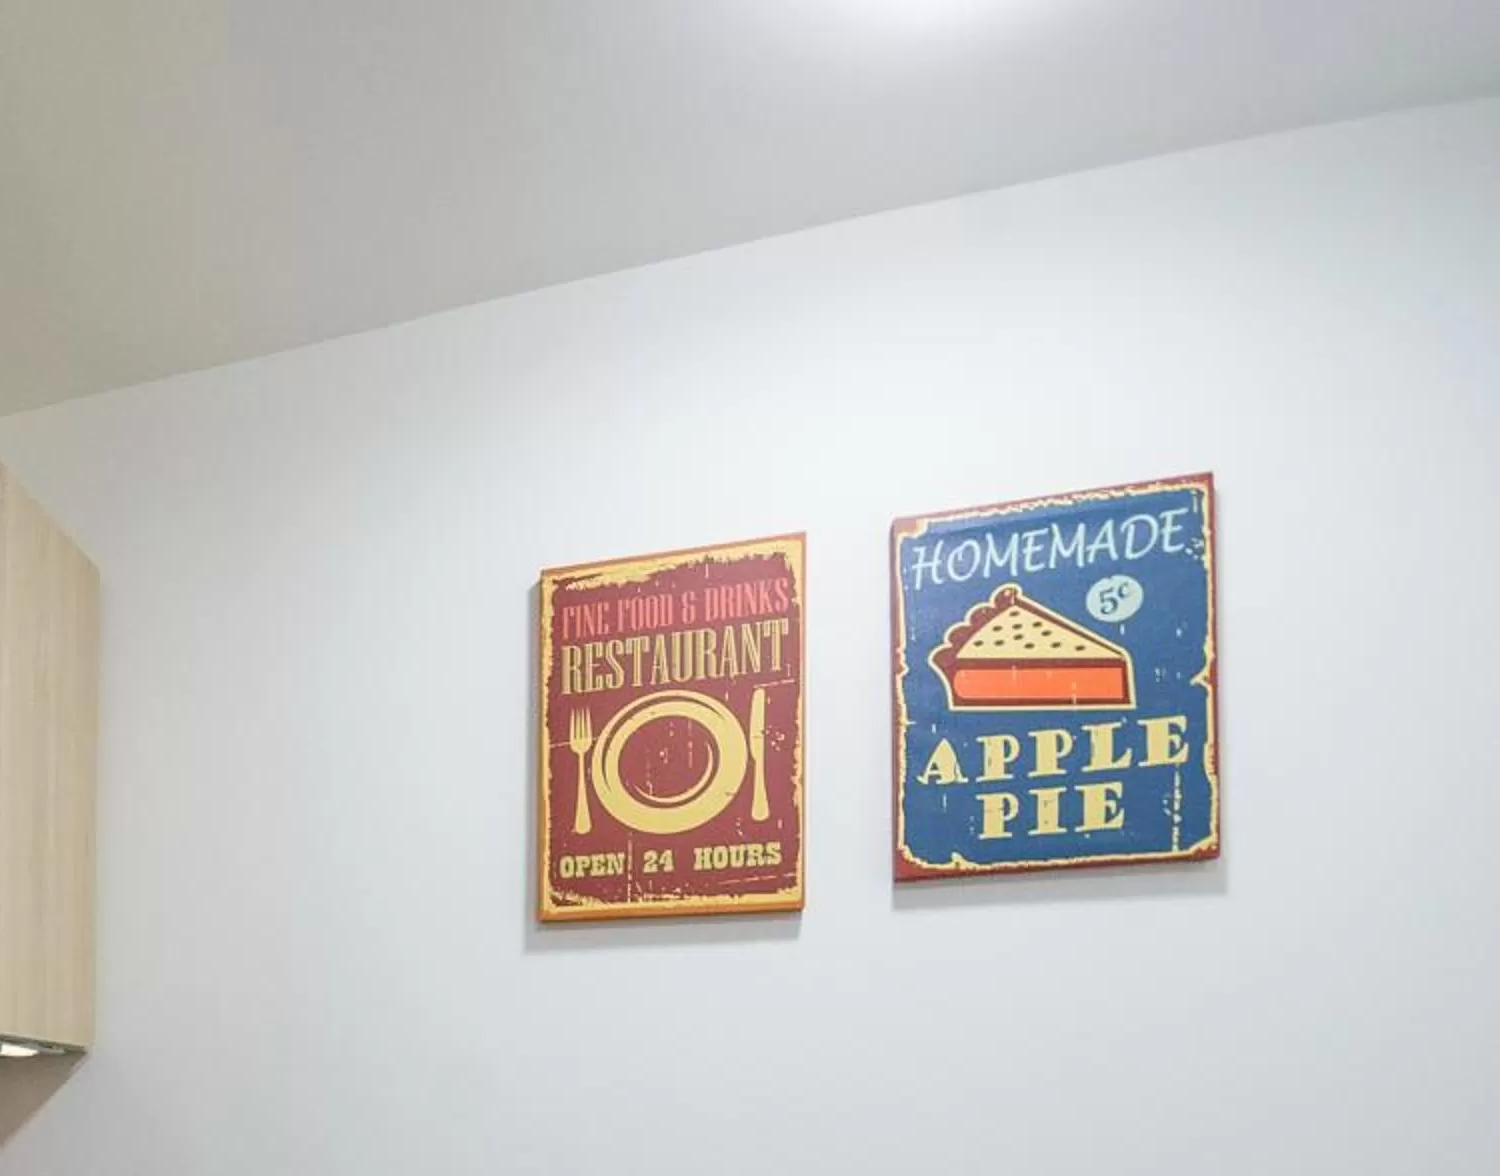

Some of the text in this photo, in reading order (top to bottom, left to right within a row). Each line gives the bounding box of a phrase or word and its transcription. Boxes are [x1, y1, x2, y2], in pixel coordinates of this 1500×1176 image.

[911, 507, 1189, 591] HOMEMADE
[617, 593, 674, 632] FOOD
[704, 577, 789, 622] DRINKS
[561, 617, 789, 695] RESTAURANT
[916, 715, 1190, 784] APPLE
[975, 781, 1125, 840] PIE
[559, 841, 782, 879] OPEN 24 HOURS
